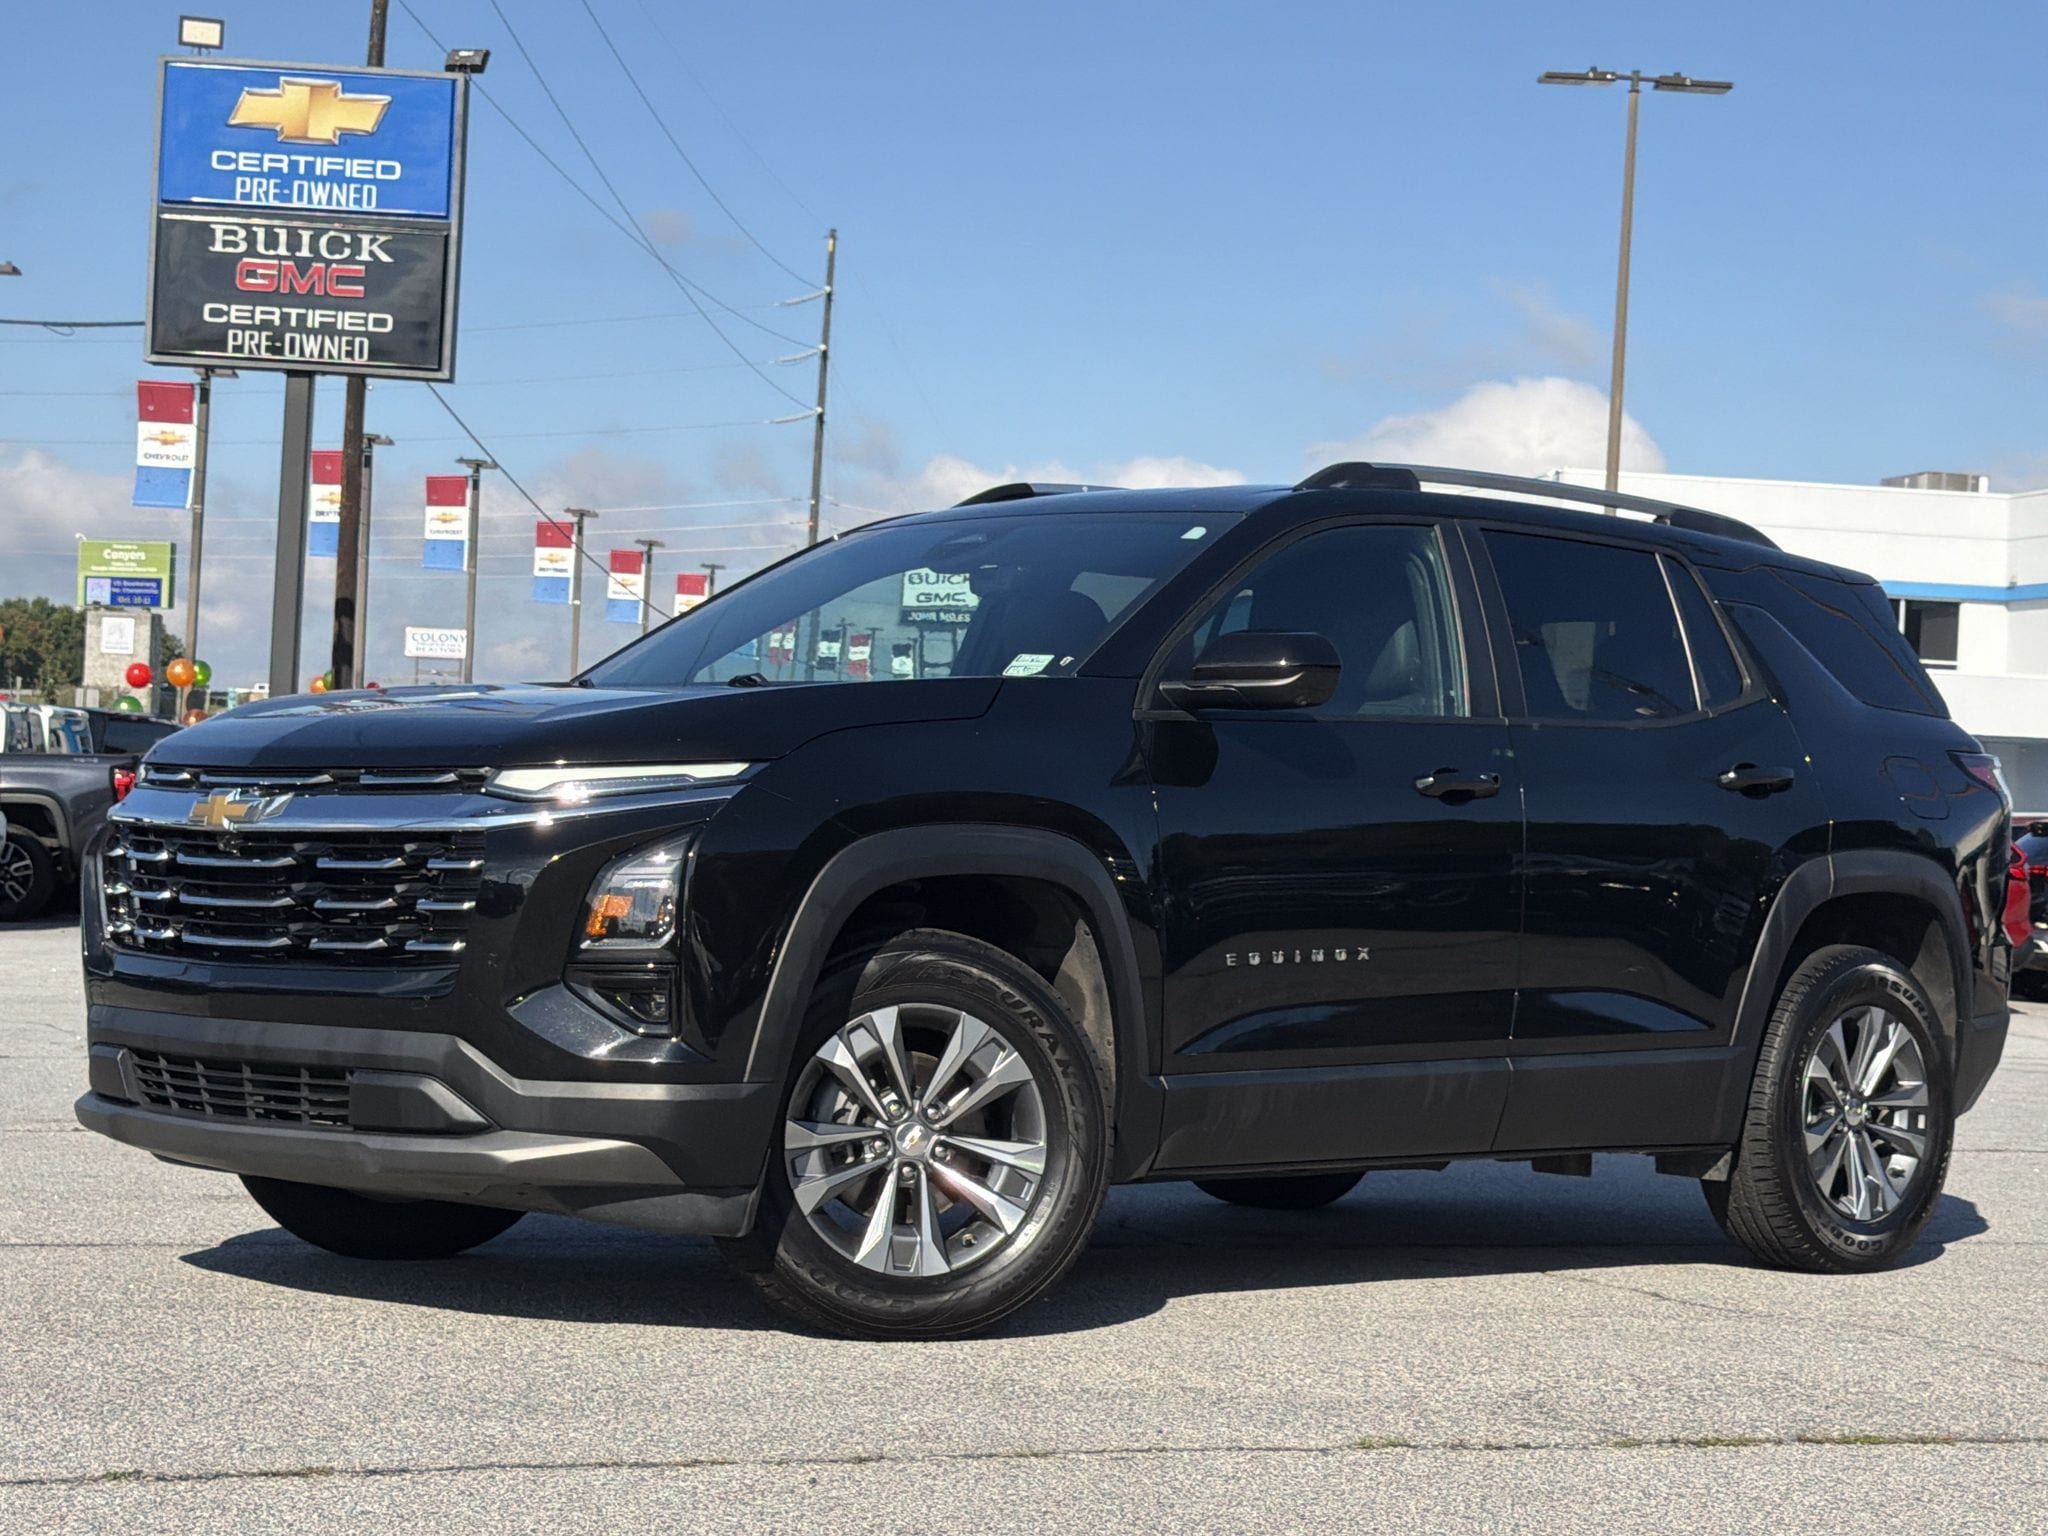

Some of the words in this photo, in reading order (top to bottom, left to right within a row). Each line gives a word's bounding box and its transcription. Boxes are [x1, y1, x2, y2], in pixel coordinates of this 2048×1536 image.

[211, 150, 401, 180] CERTIFIED
[235, 177, 377, 209] PRE-OWNED
[208, 223, 394, 263] BUICK
[235, 258, 366, 298] GMC
[202, 303, 394, 333] CERTIFIED
[227, 329, 369, 362] PRE-OWNED
[143, 452, 189, 462] CHEVROLET
[915, 591, 968, 604] GMC
[1226, 947, 1370, 966] EQUINOX
